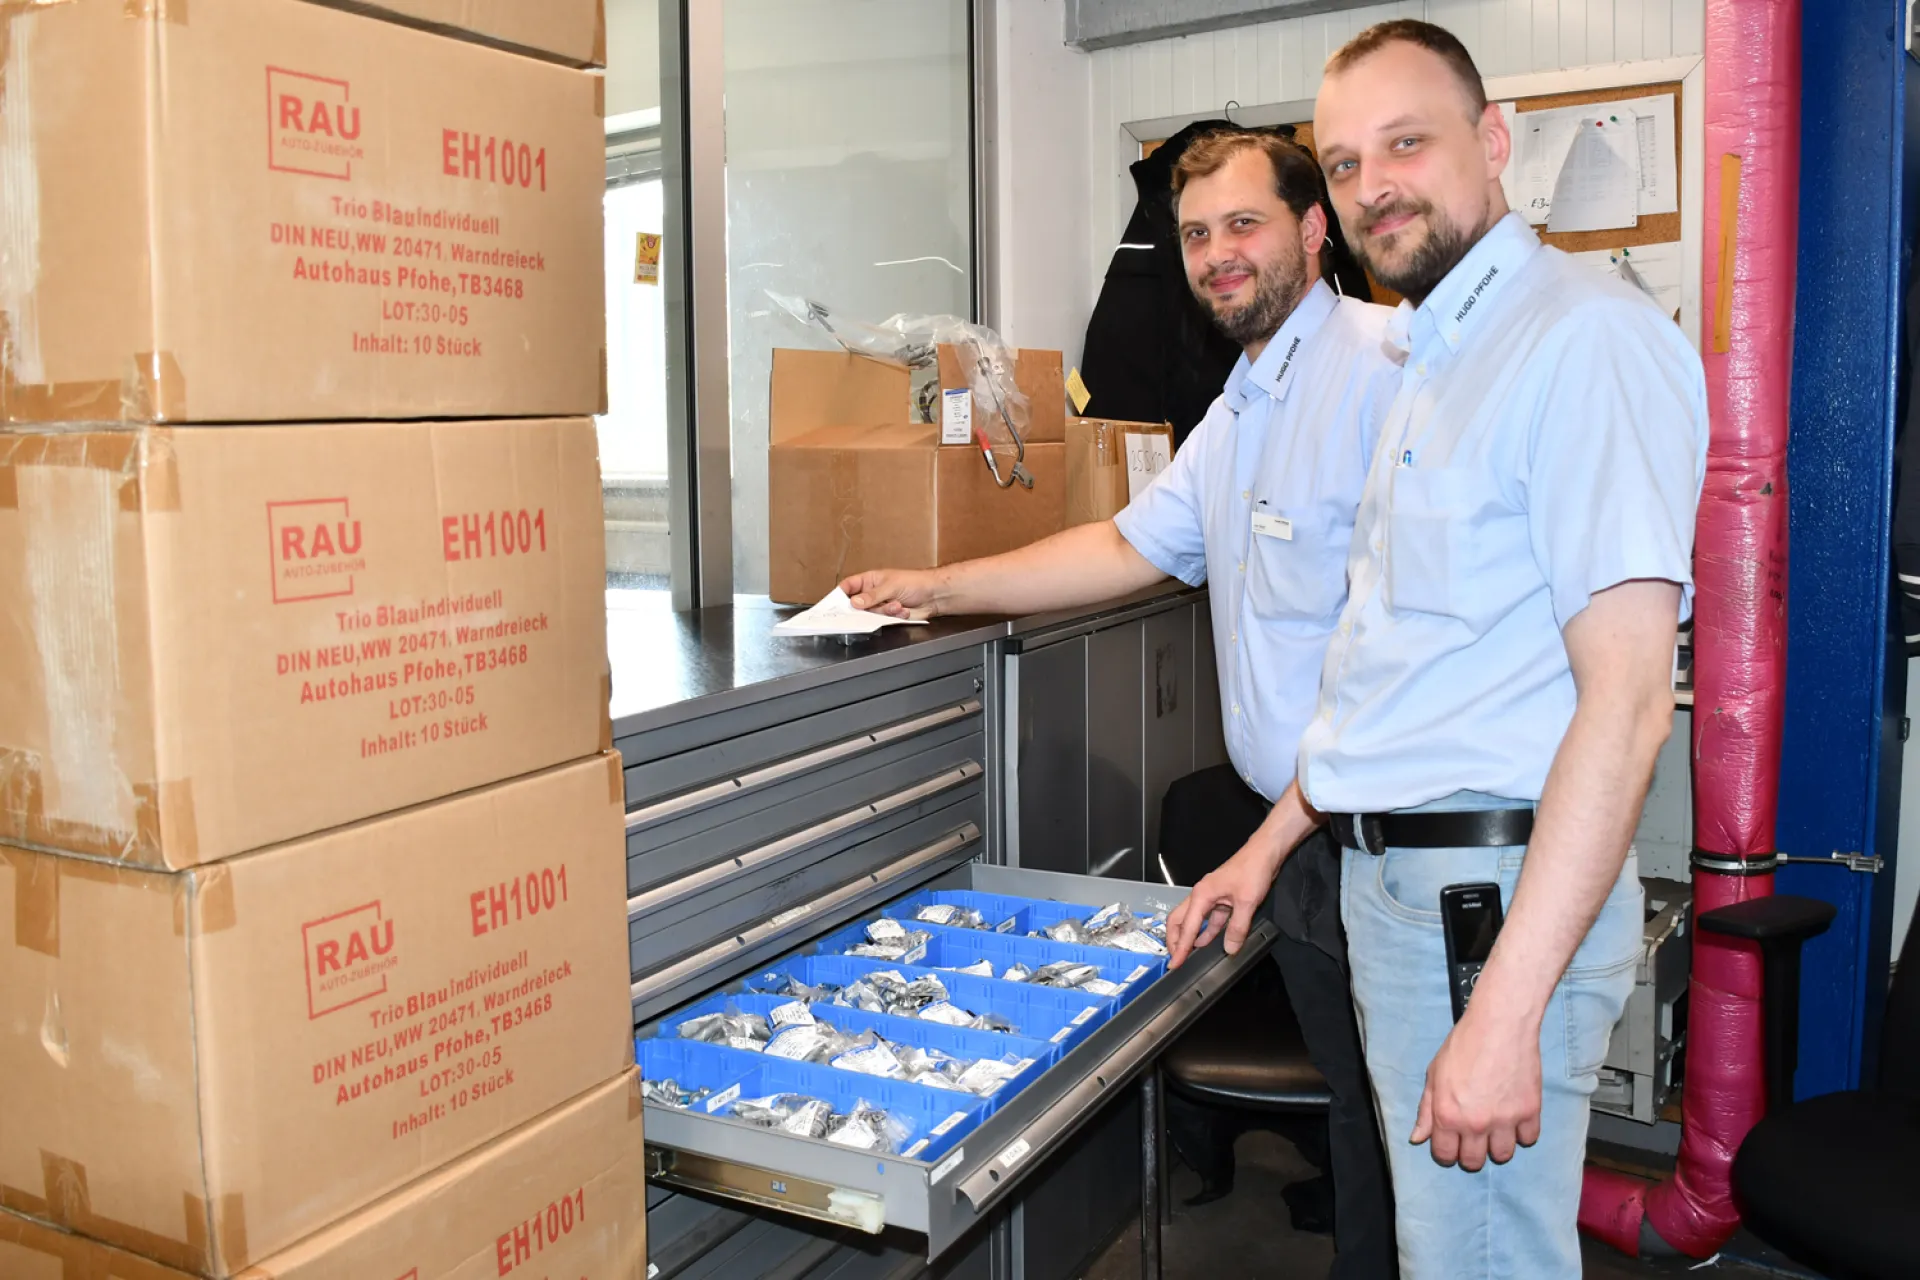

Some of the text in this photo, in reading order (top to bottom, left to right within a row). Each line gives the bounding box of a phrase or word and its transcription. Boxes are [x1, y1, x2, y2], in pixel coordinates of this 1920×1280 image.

[280, 94, 361, 140] RAU
[443, 128, 546, 192] EH1001
[331, 196, 367, 218] Trio
[372, 200, 415, 228] Blau
[271, 222, 305, 246] DIN
[293, 256, 391, 287] Autohaus
[382, 300, 468, 326] LOT:30-05
[1455, 265, 1499, 323] HUGO PFOHE
[353, 332, 482, 357] Inhalt: 10 Stück
[281, 520, 362, 560] RAU
[442, 508, 546, 561] EH1001
[336, 609, 371, 631] Trio
[376, 605, 419, 626] Blau
[276, 650, 311, 675] DIN
[300, 671, 398, 704] Autohaus
[390, 685, 474, 720] LOT:30-05
[361, 712, 488, 758] Inhalt: 10 Stück
[470, 863, 567, 937] EH1001
[316, 919, 394, 976] RAU
[369, 1004, 404, 1028] Trio
[407, 987, 447, 1016] Blau
[313, 1053, 346, 1084] DIN
[336, 1053, 429, 1106] Autohaus
[420, 1046, 502, 1097] LOT:30-05
[392, 1068, 514, 1139] Inhalt: 10 Stück
[496, 1186, 585, 1277] EH1001
